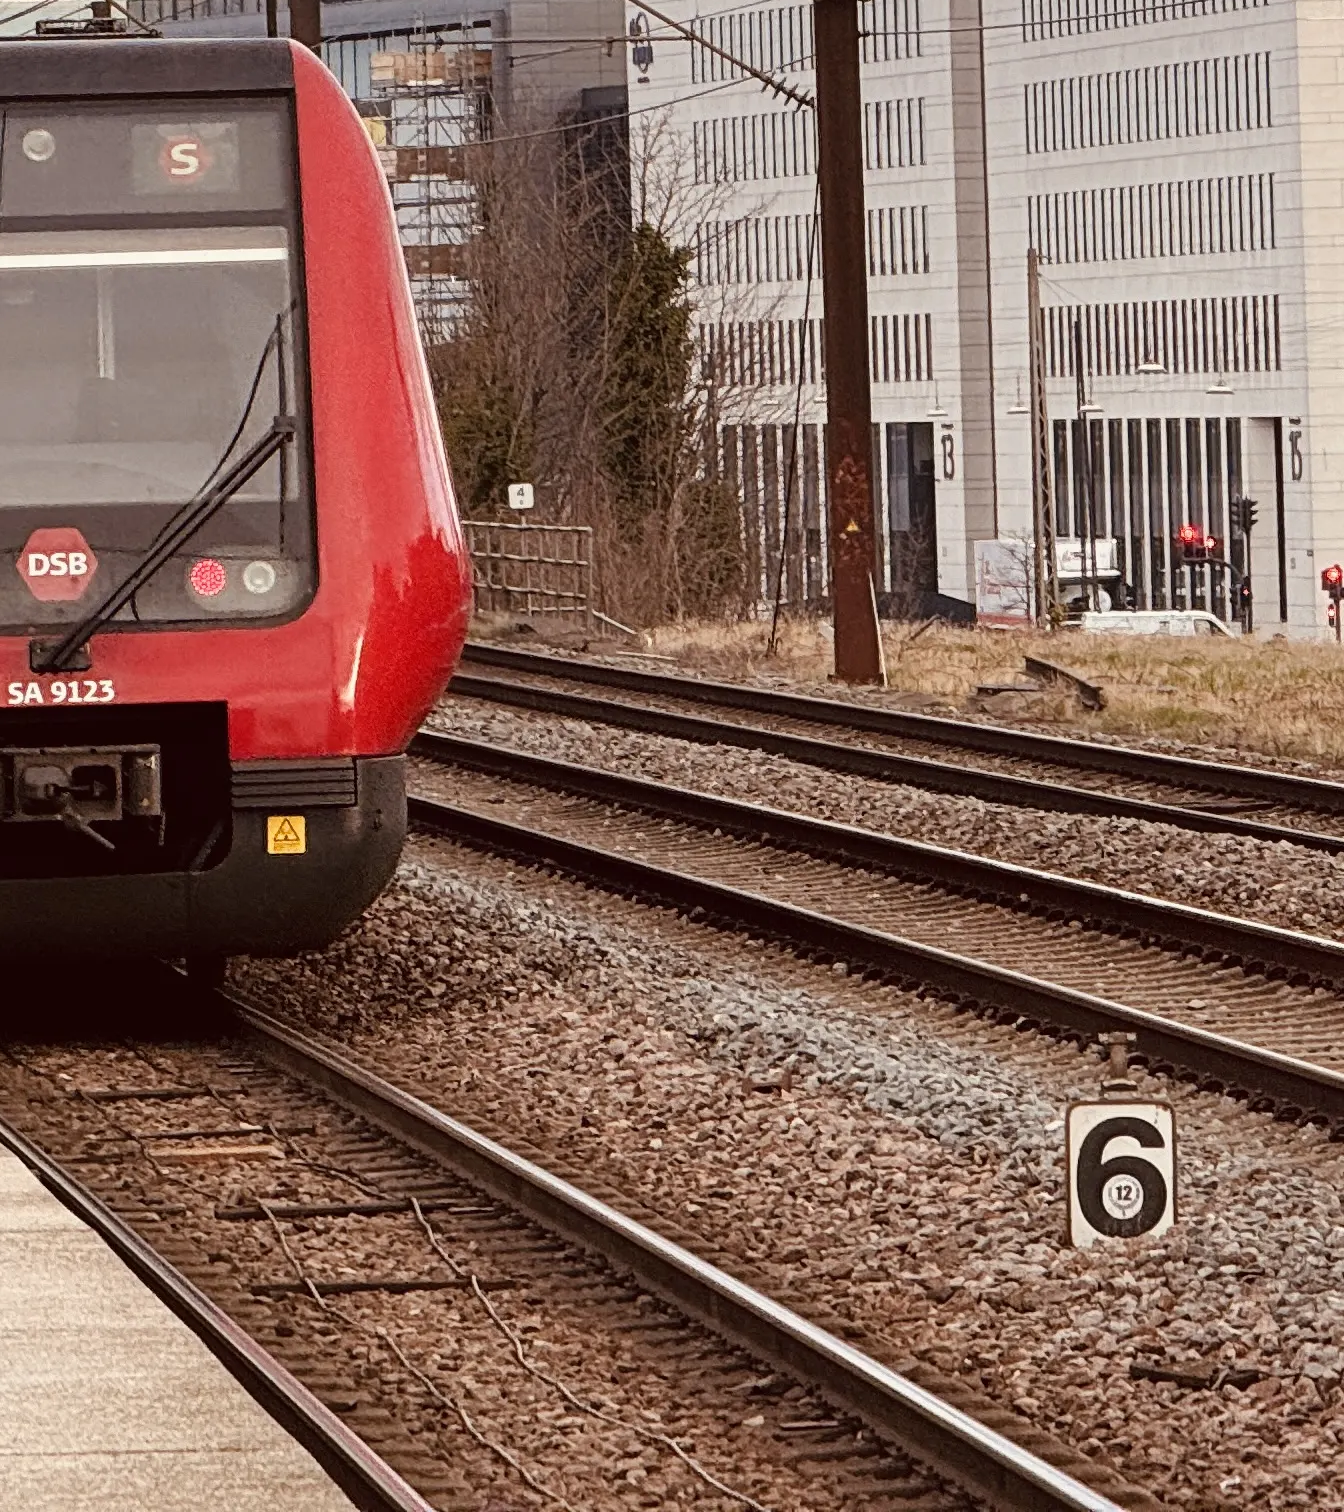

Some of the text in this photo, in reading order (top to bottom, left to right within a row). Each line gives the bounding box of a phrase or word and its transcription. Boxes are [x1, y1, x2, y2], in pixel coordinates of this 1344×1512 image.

[170, 143, 200, 176] S
[28, 552, 88, 577] DSB
[8, 679, 115, 705] SA 9123
[1076, 1116, 1167, 1238] 6
[1115, 1185, 1133, 1201] 12
